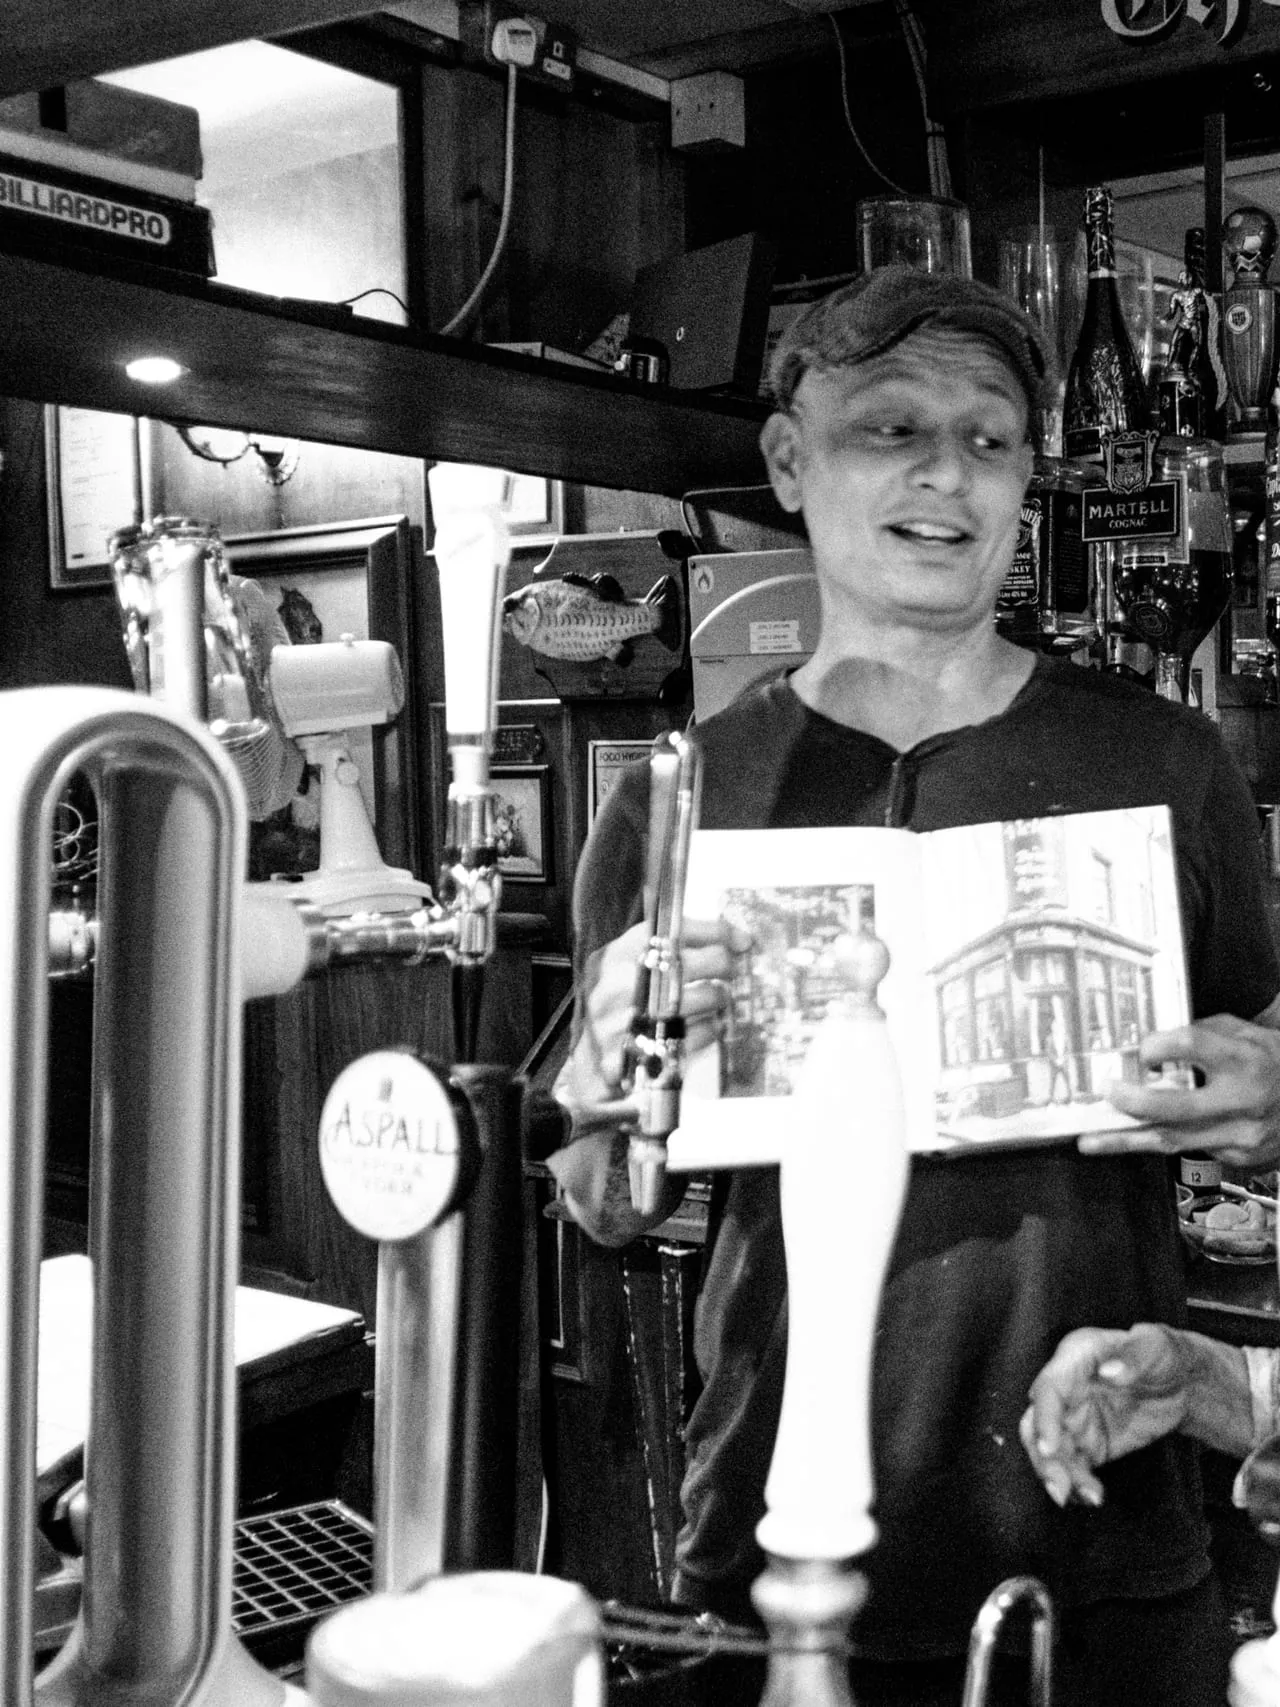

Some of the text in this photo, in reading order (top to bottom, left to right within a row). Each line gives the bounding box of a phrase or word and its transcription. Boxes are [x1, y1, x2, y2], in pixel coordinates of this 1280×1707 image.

[1088, 500, 1170, 519] MARTELL
[1108, 517, 1148, 530] COGNAC
[334, 1101, 459, 1155] ASPALL
[1191, 1172, 1202, 1183] 12
